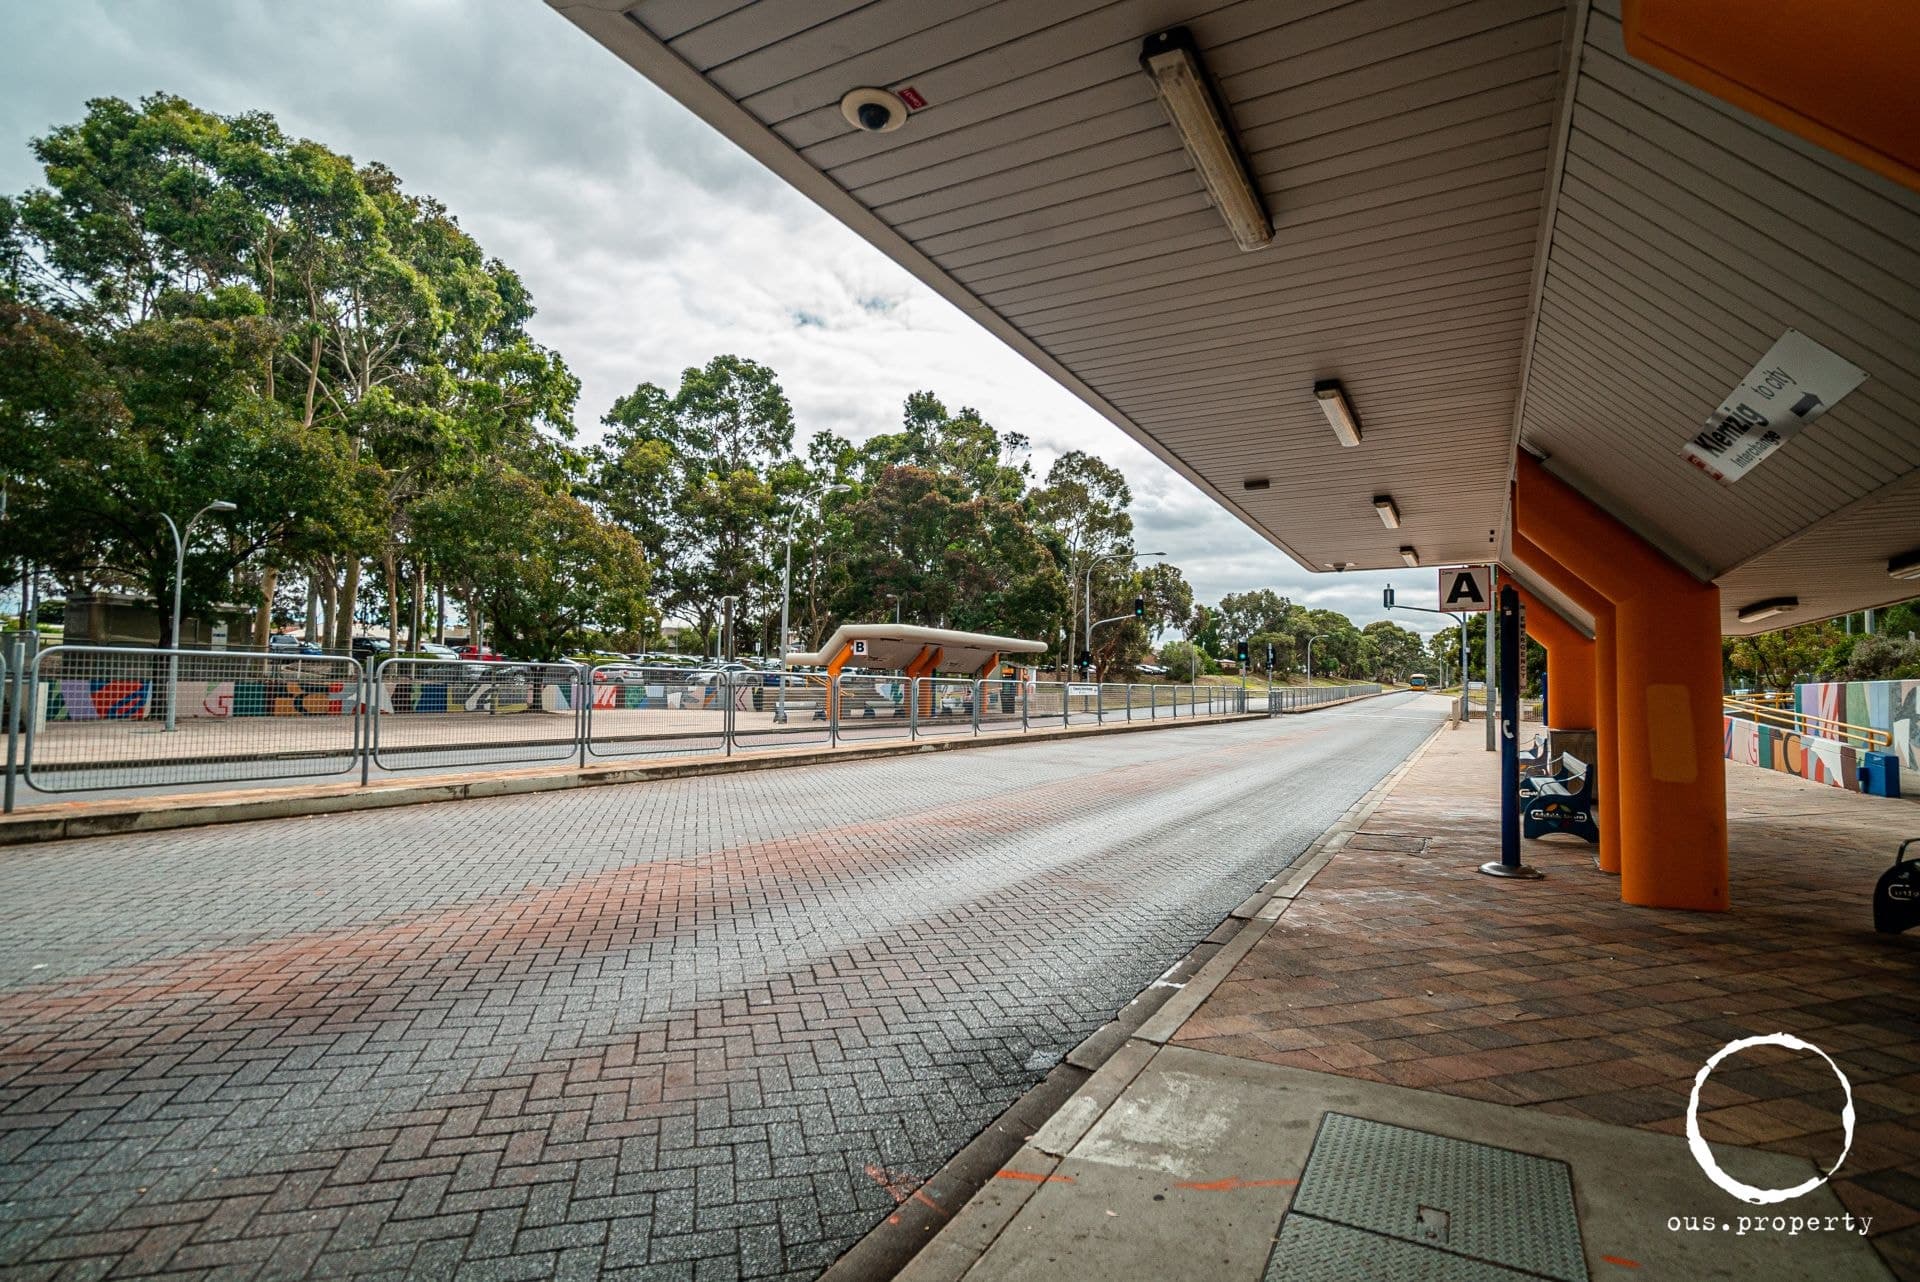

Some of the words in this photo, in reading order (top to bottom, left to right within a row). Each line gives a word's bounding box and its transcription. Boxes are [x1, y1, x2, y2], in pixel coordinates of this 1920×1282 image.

[1751, 385, 1775, 401] to
[1769, 366, 1797, 393] city
[1694, 403, 1770, 459] Klemzig
[1730, 430, 1781, 469] Interchange
[1446, 571, 1485, 604] A
[855, 641, 865, 653] B
